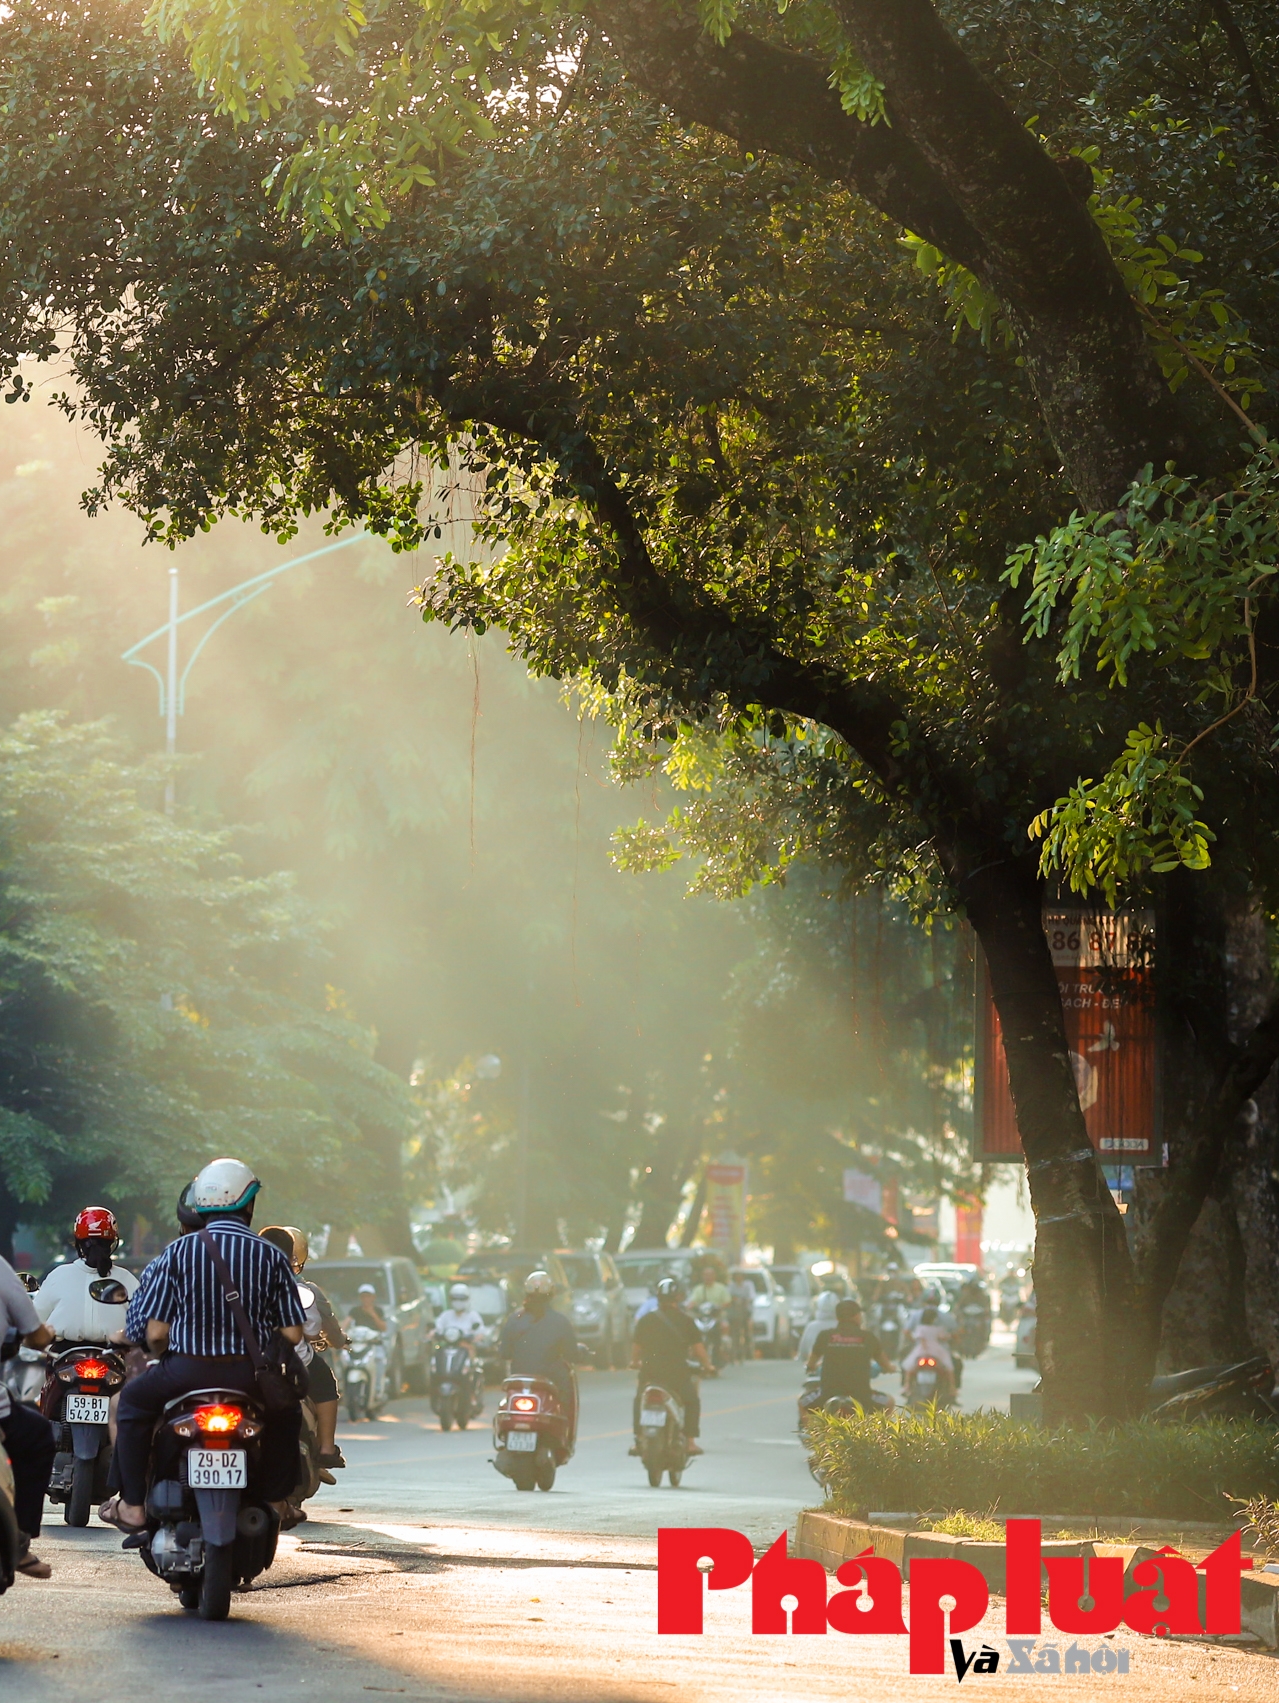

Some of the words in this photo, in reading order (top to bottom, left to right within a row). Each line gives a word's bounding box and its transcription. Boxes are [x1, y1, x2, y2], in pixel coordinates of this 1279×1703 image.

[1052, 931, 1081, 952] 86
[74, 1397, 103, 1410] 59-B1
[69, 1408, 107, 1422] 542.87
[197, 1452, 237, 1468] 29-D2
[193, 1469, 242, 1485] 390.17
